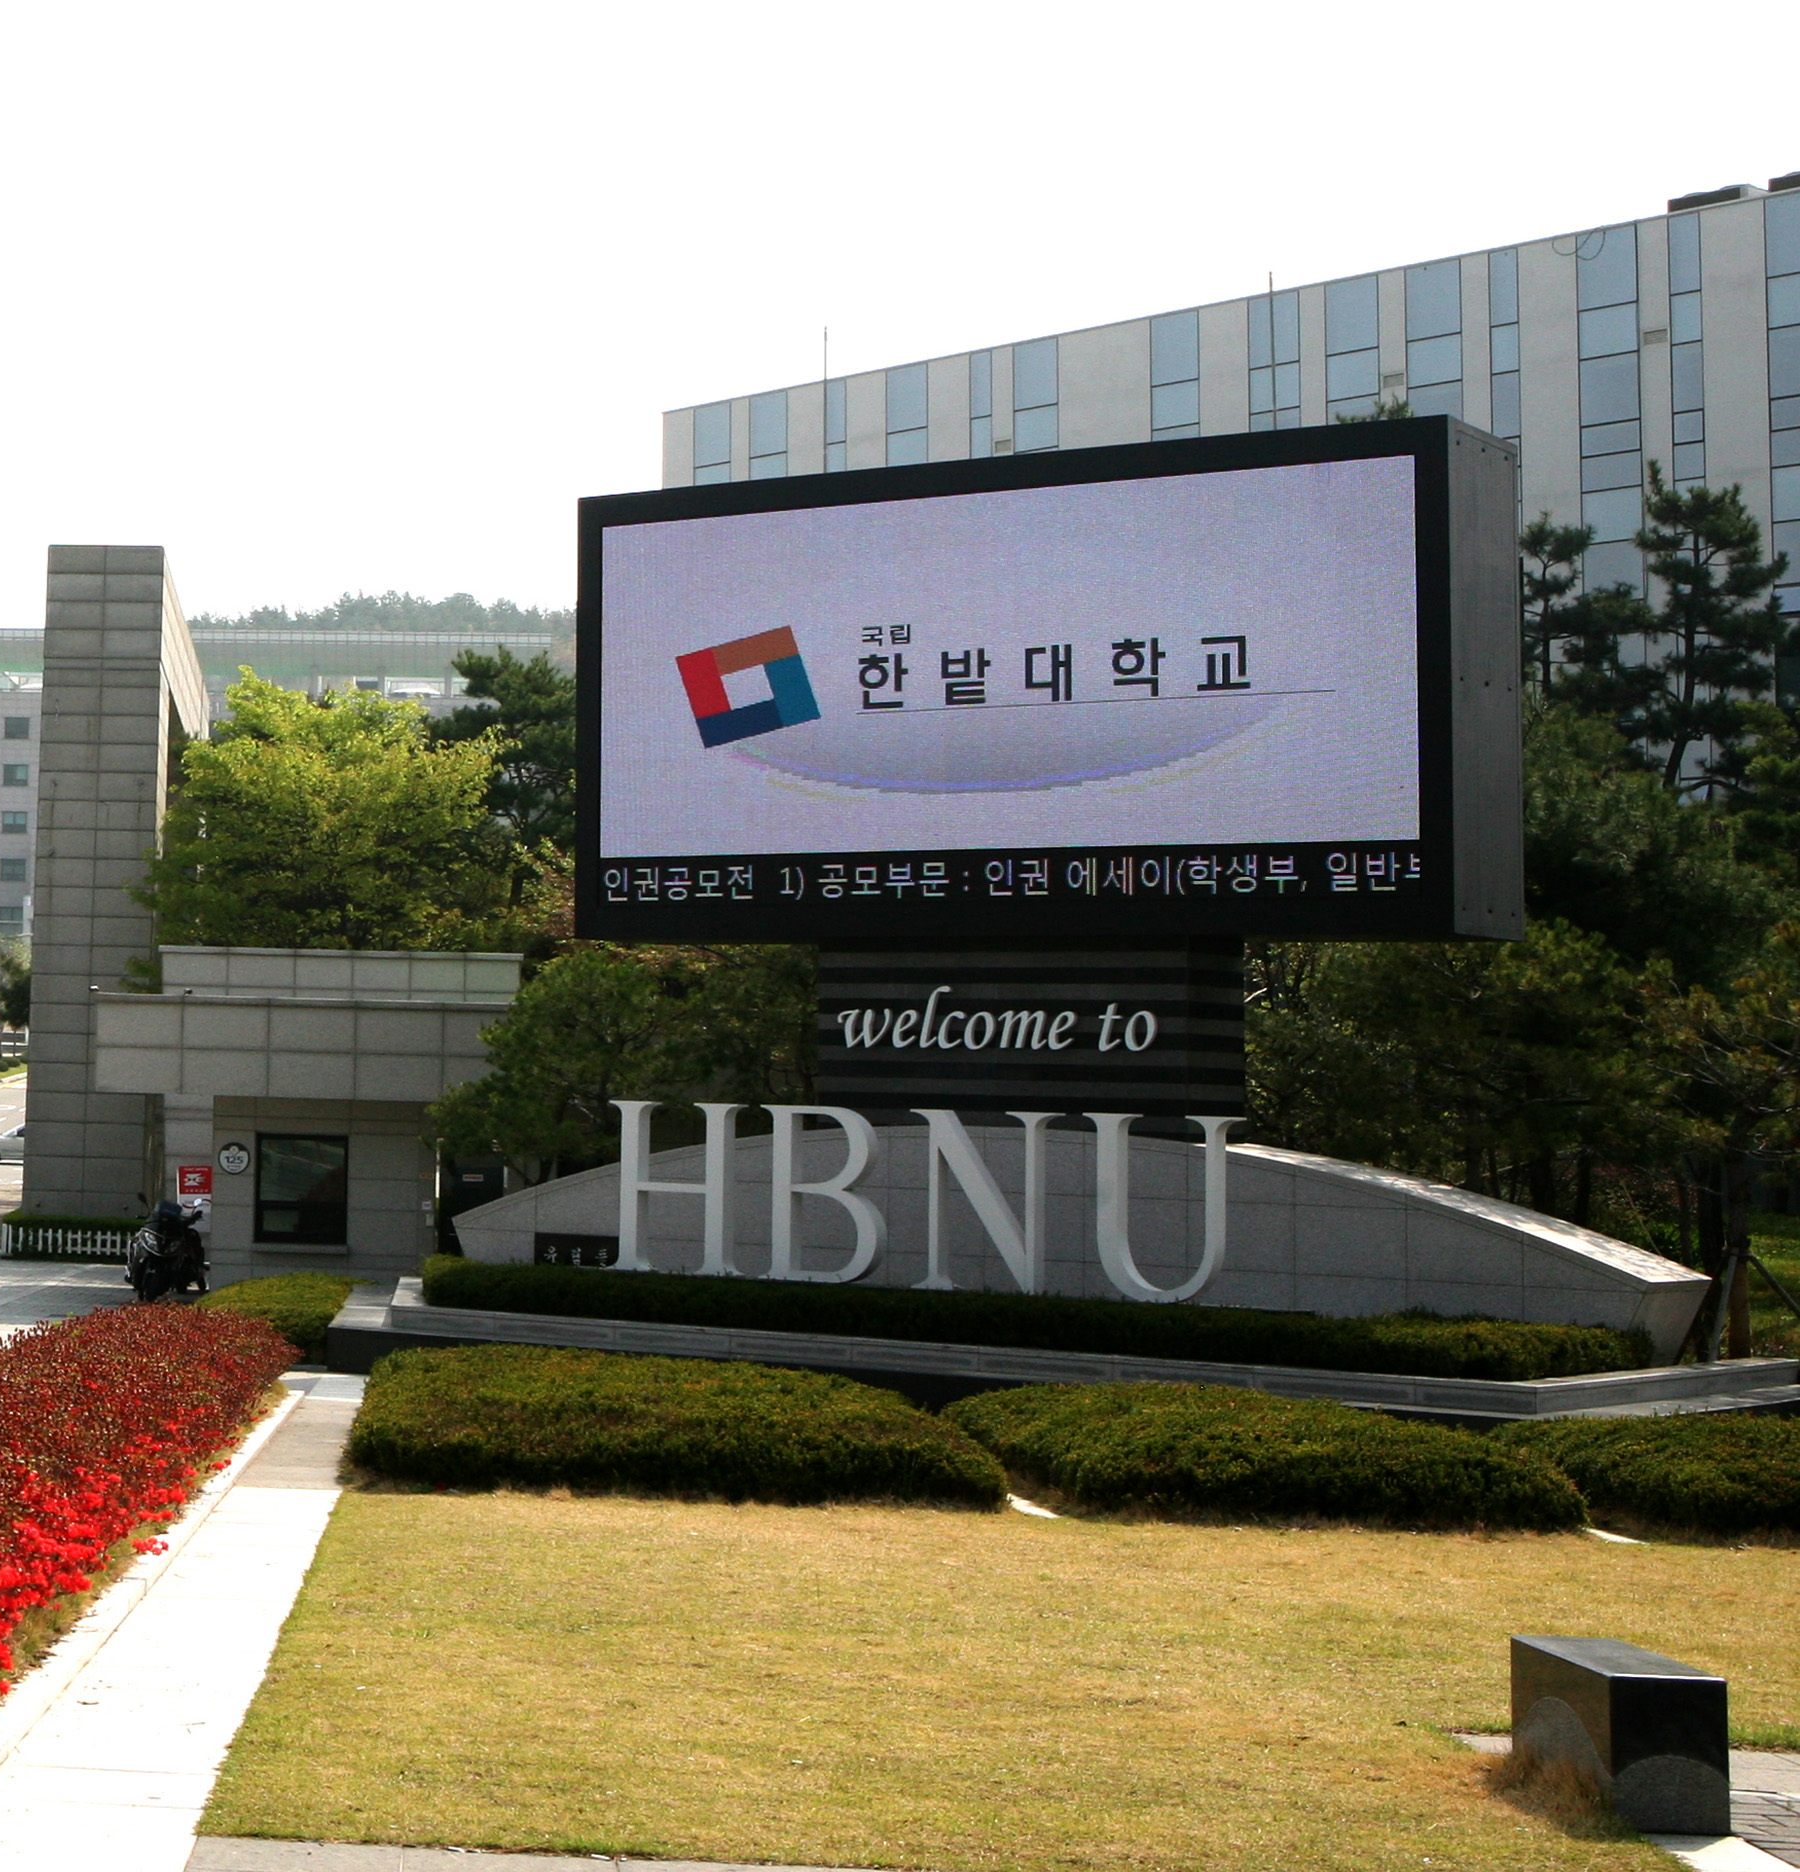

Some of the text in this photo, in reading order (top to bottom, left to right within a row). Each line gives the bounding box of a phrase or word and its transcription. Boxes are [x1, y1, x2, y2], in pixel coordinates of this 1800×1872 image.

[862, 624, 911, 646] 국립
[858, 635, 1251, 709] 한밭대학교
[604, 866, 755, 902] 인권공모전
[780, 866, 805, 900] 1)
[817, 862, 950, 899] 공모부문
[985, 859, 1050, 897] 인권
[1067, 853, 1307, 896] 에세이(학생부,
[837, 985, 1158, 1052] welcome to
[225, 1156, 244, 1164] 125
[609, 1100, 1246, 1304] HBNU
